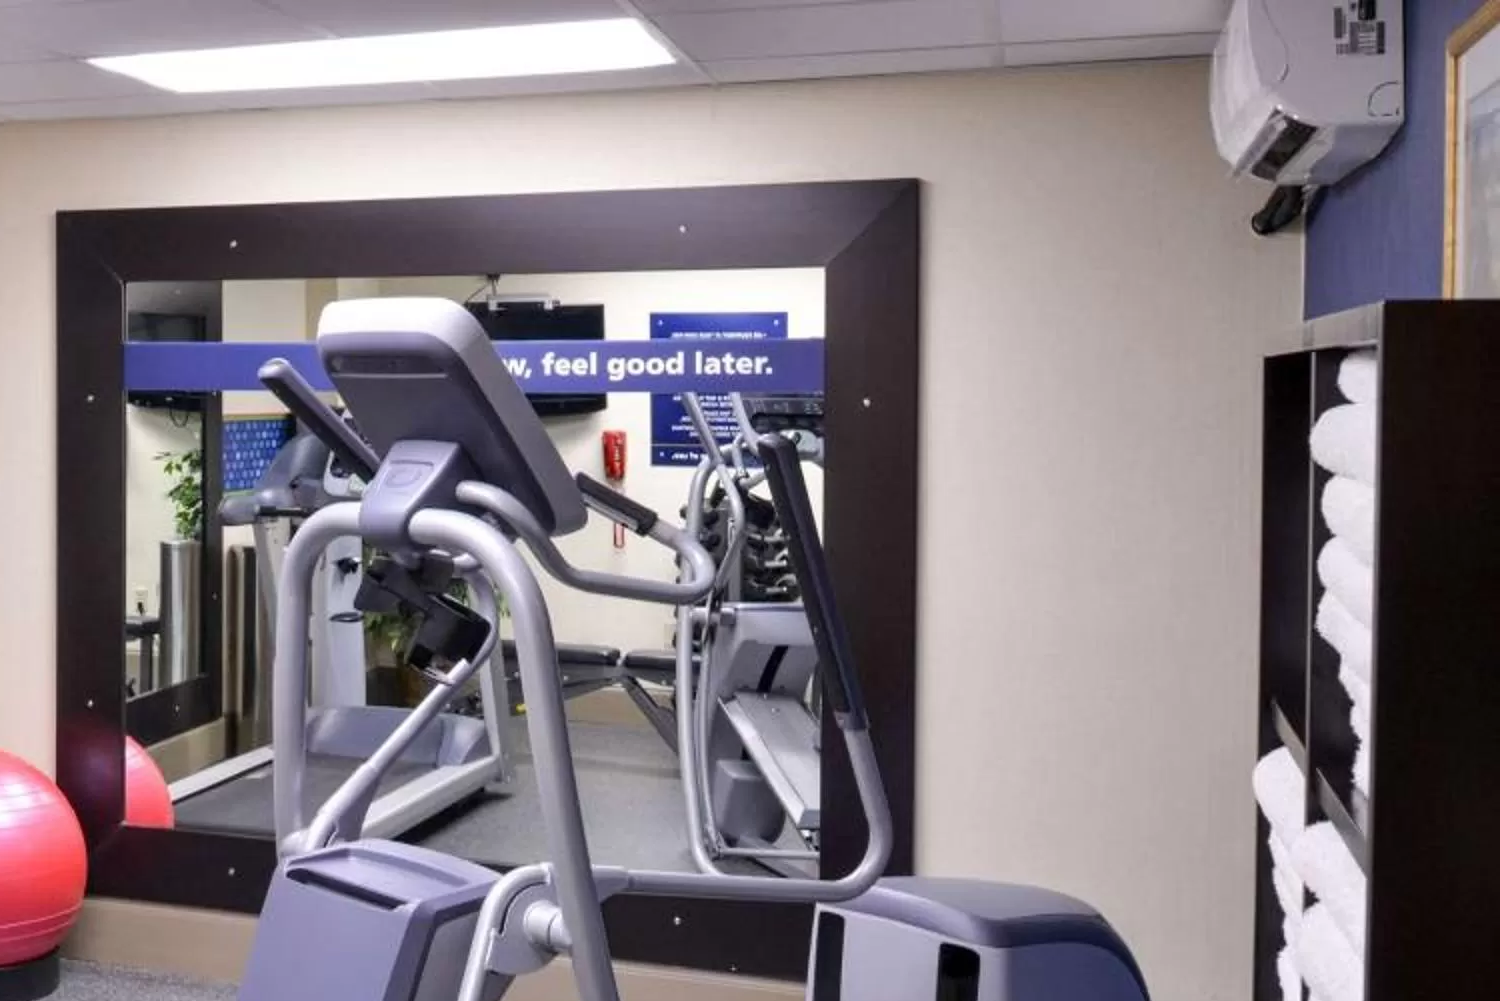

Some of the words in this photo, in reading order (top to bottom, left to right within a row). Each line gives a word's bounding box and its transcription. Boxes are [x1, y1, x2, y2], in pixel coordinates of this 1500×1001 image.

[542, 351, 597, 376] feel
[607, 351, 684, 381] good
[695, 351, 773, 375] later.
